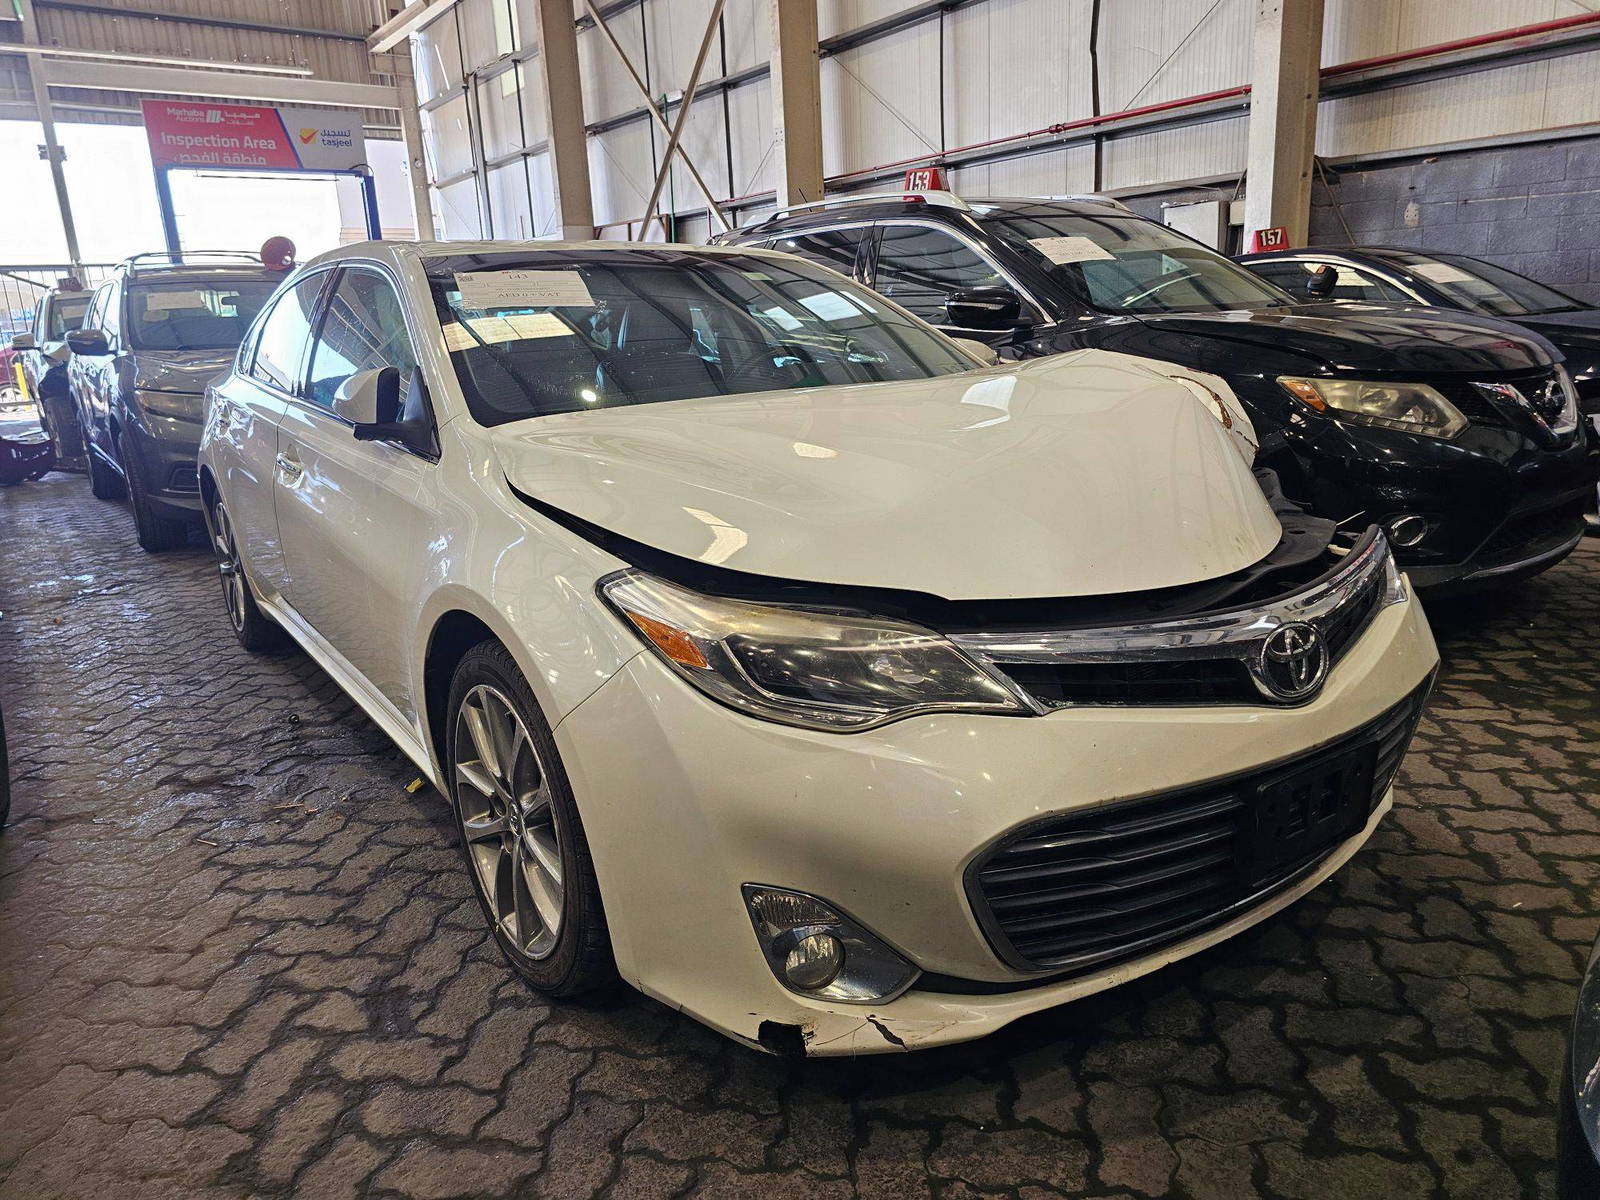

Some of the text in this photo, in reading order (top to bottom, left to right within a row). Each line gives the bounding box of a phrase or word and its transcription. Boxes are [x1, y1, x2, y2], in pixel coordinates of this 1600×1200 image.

[166, 107, 205, 117] Marhaba
[320, 129, 351, 138] تسجيل
[160, 131, 277, 150] Inspection Area
[321, 138, 352, 148] tasjeel
[223, 152, 267, 165] منطقة
[909, 171, 930, 191] 153
[1260, 228, 1282, 246] 157
